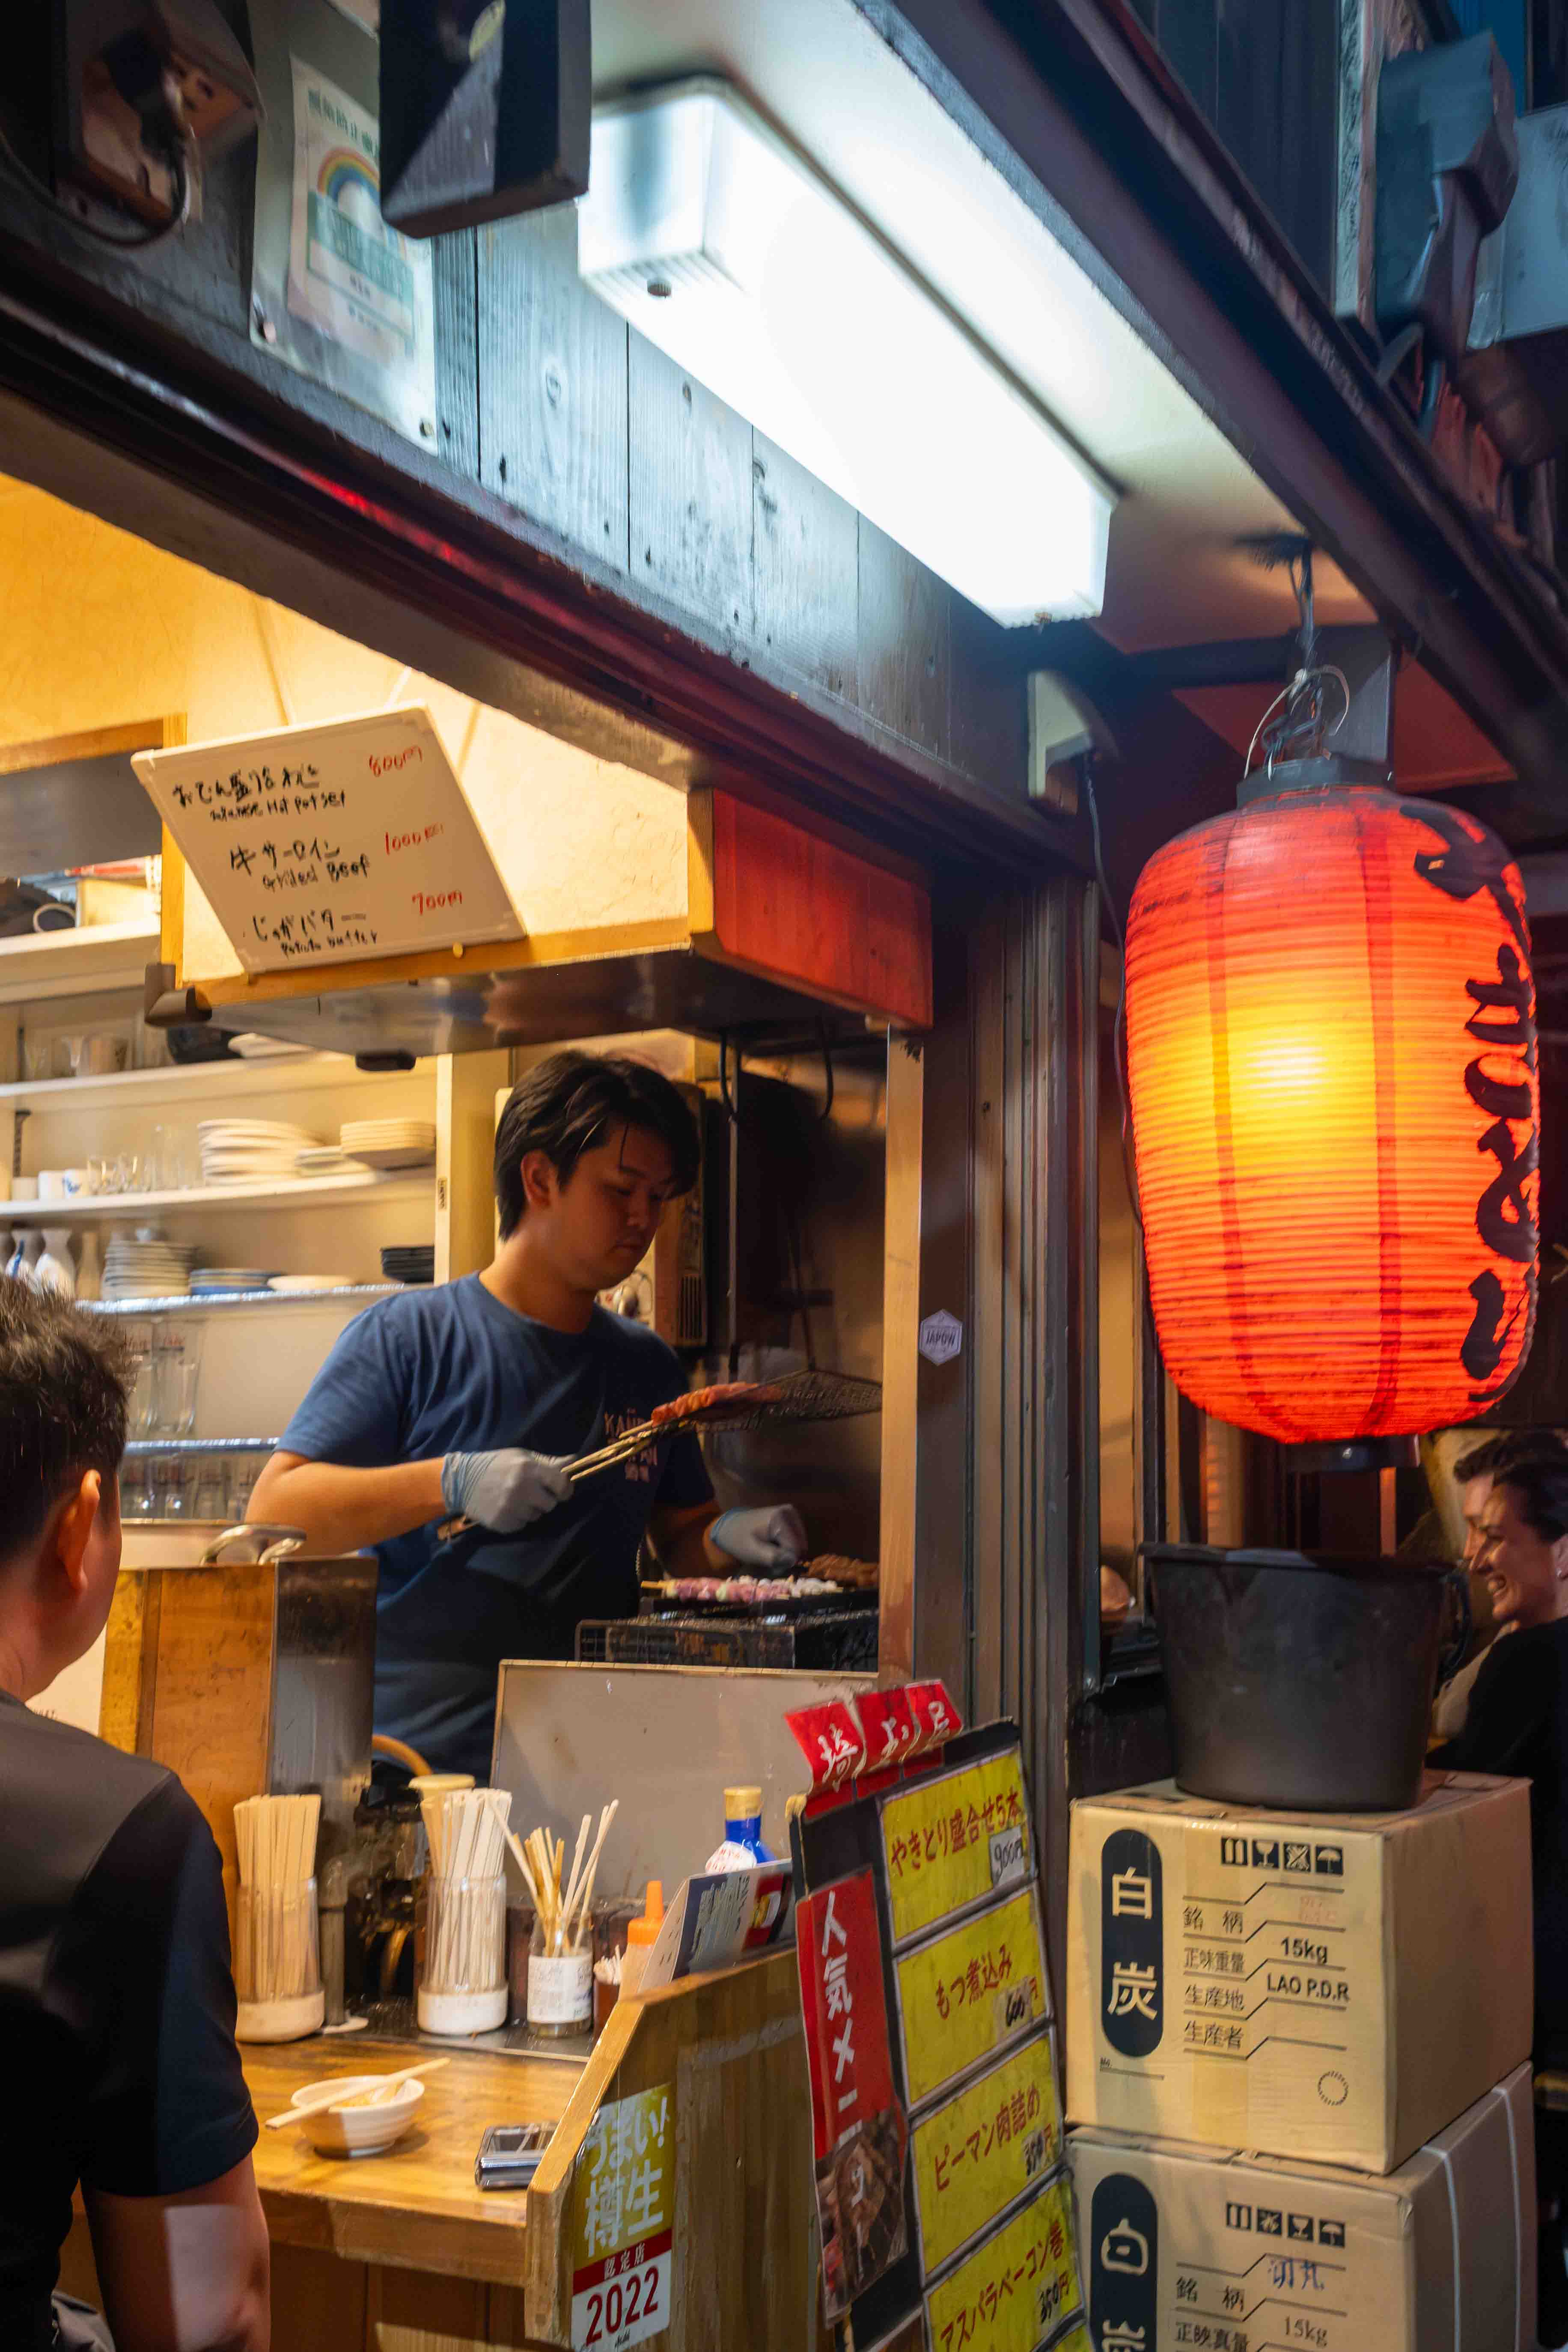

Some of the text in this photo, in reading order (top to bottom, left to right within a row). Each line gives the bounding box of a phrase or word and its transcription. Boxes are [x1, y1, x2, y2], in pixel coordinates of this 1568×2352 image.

[1106, 1866, 1158, 2021] 白炭
[1280, 1937, 1329, 1965] 15kg
[1184, 1983, 1245, 2012] 生産地
[1267, 1972, 1302, 1997] LAO
[1184, 2019, 1243, 2051] 生産者
[585, 2265, 659, 2347] 2022
